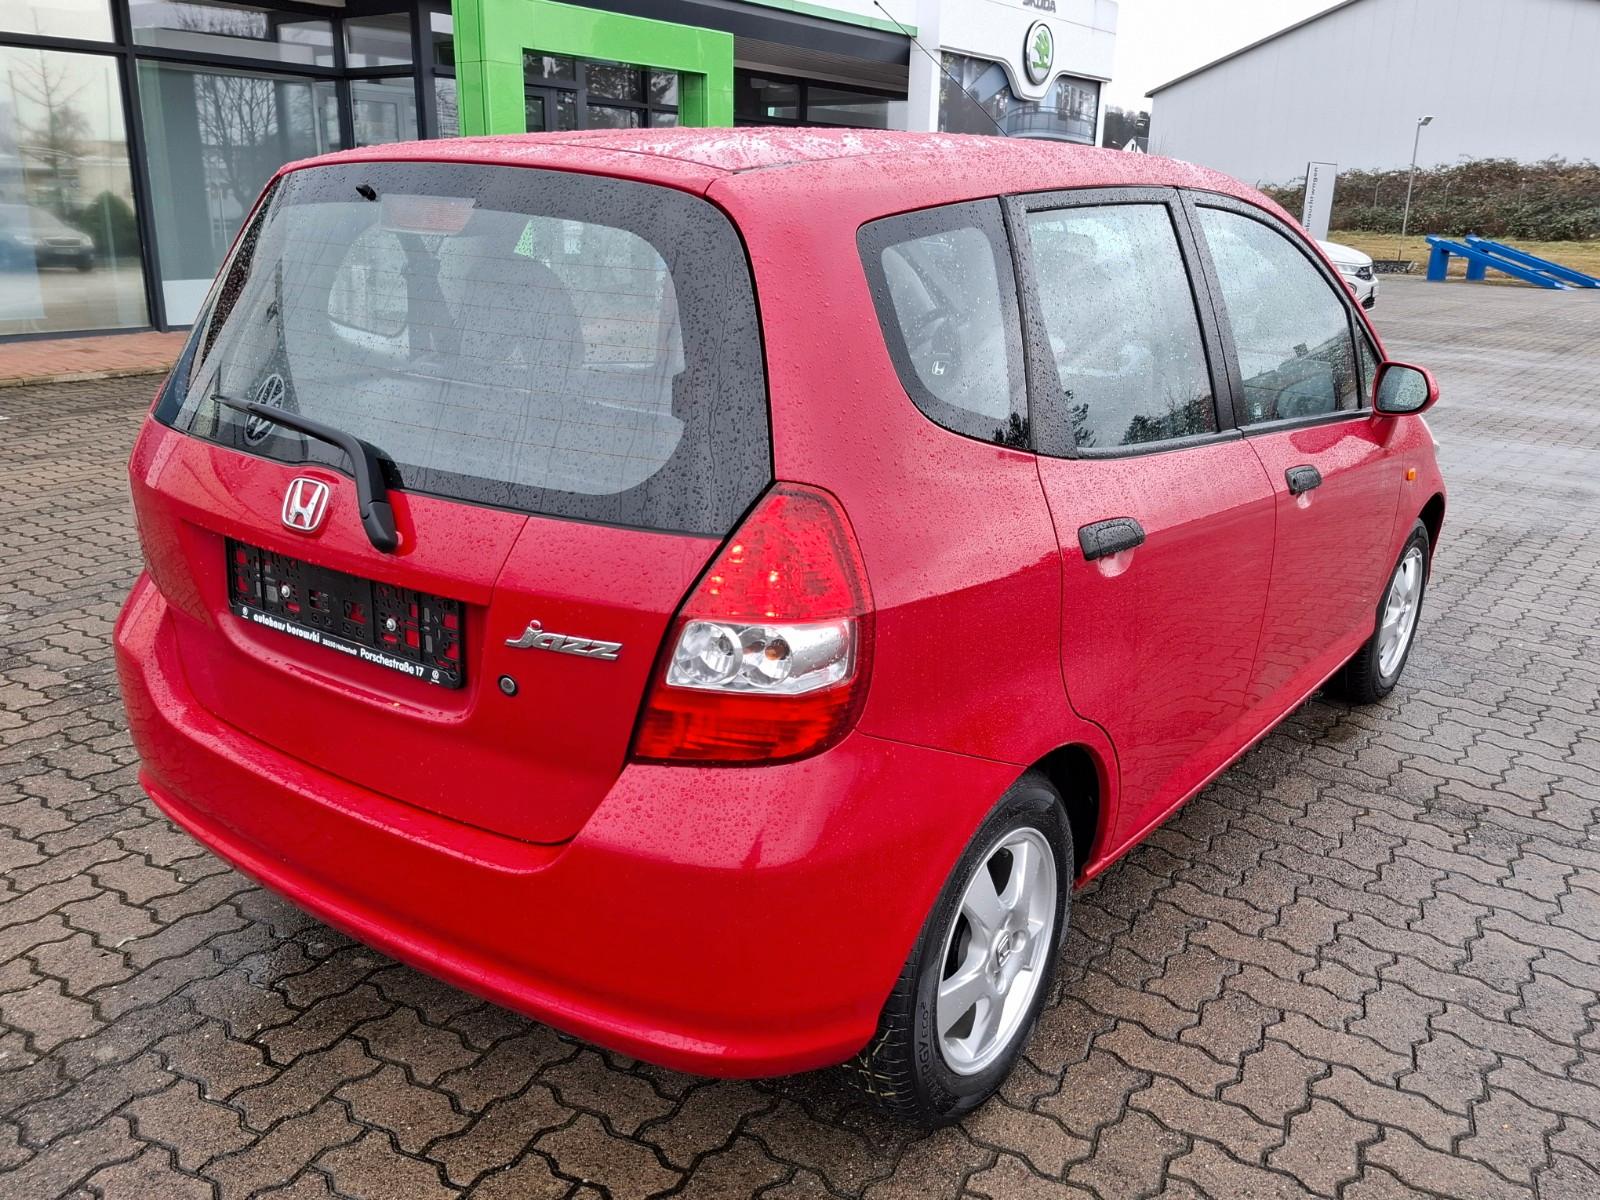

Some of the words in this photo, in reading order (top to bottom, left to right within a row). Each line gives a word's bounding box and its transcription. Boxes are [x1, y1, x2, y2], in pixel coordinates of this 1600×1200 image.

[1305, 167, 1319, 232] ebrauchtwagen
[504, 619, 623, 661] jazz
[360, 647, 415, 675] Porschestraße
[415, 665, 424, 677] 17
